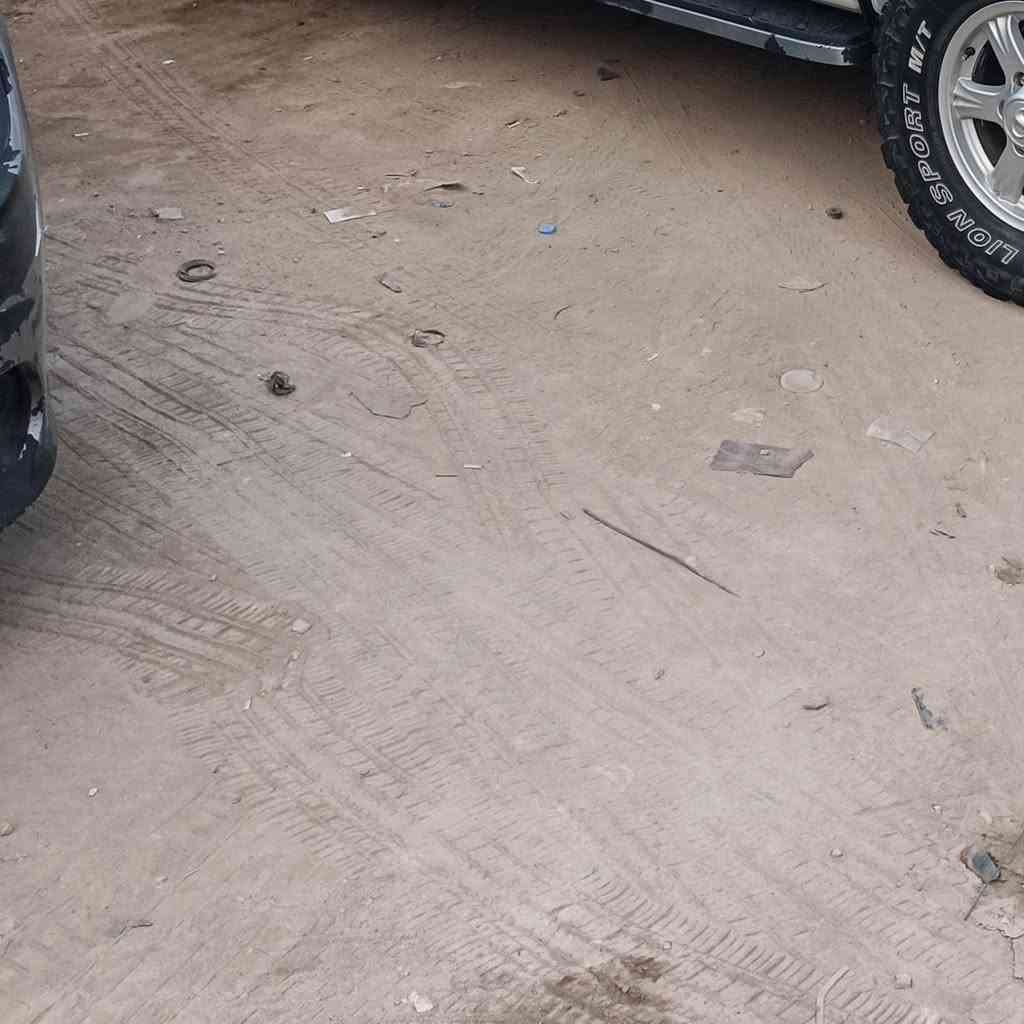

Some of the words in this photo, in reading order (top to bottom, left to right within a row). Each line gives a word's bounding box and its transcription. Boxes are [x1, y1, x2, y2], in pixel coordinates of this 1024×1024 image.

[908, 20, 932, 74] M/T
[902, 82, 954, 206] SPORT
[947, 208, 1020, 265] LION
